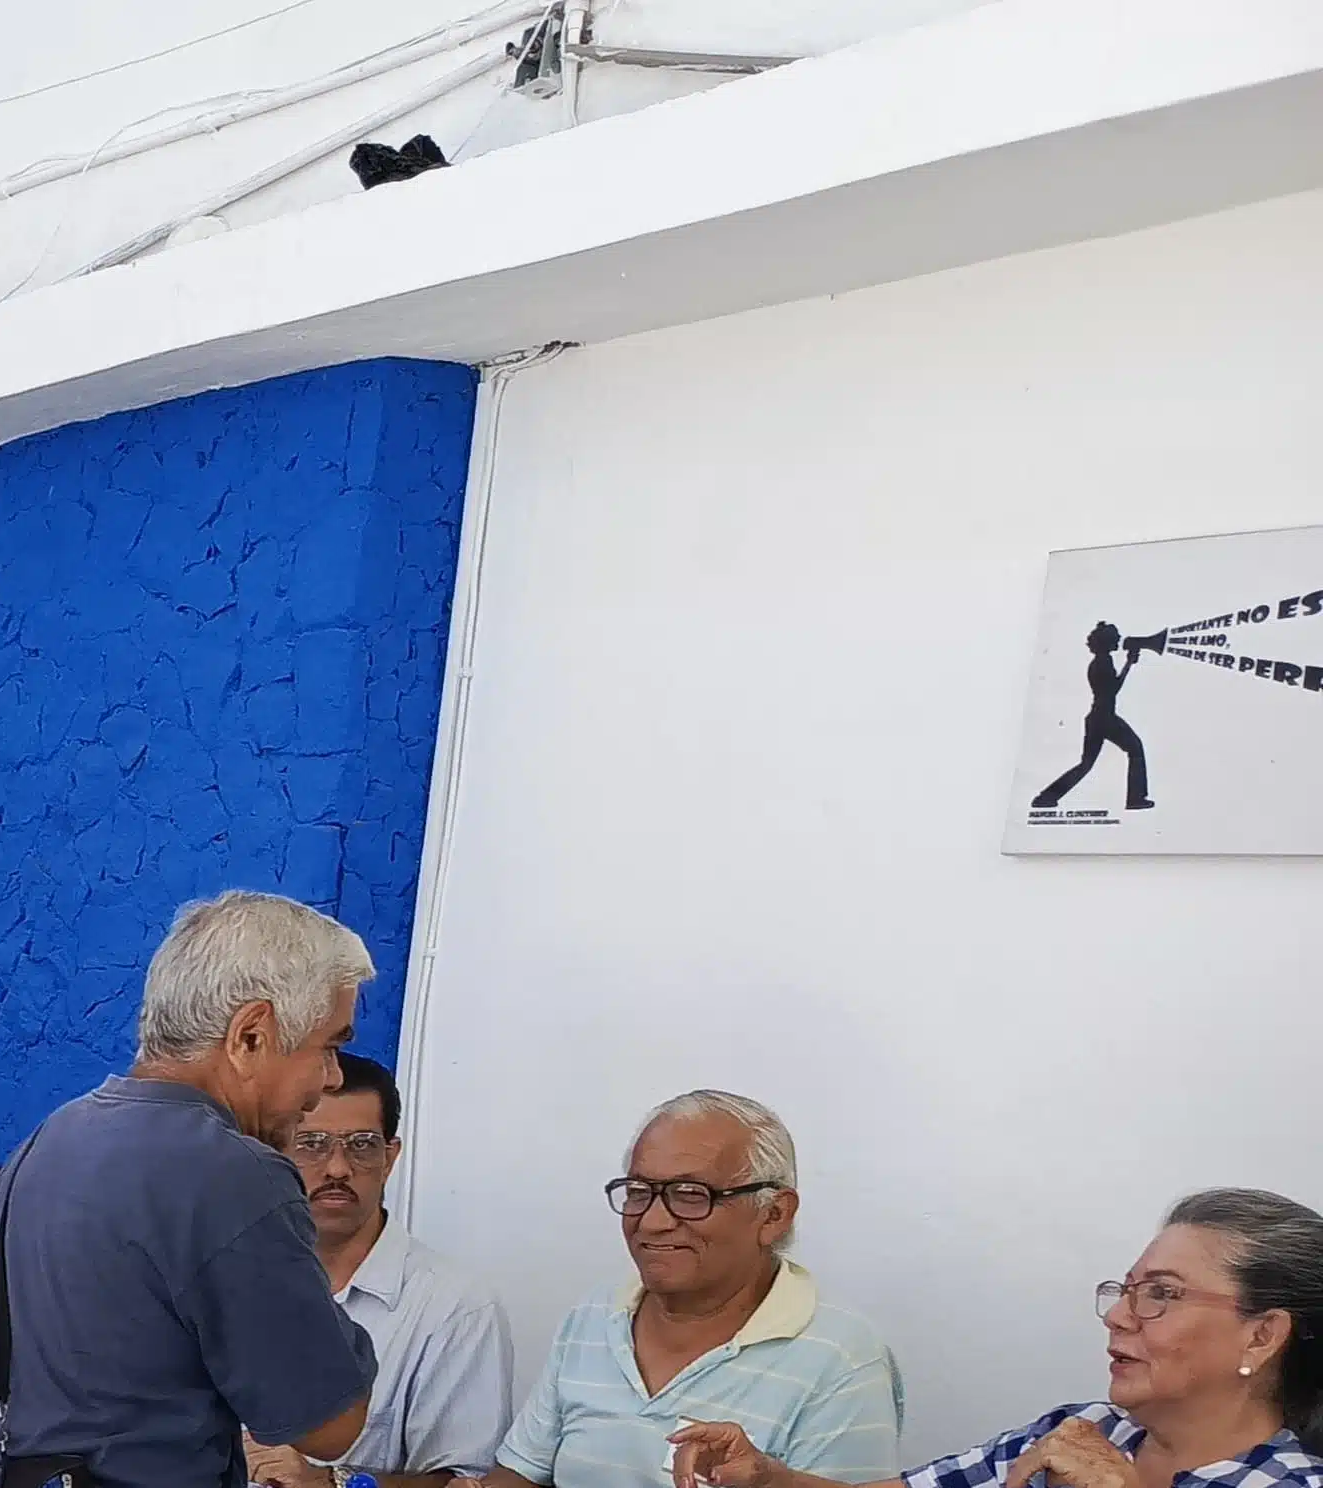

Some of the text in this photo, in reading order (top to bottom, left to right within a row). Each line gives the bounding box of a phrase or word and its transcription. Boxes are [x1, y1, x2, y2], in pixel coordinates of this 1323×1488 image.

[1236, 605, 1270, 625] NO
[1194, 650, 1206, 662] DE
[1209, 652, 1235, 669] SER
